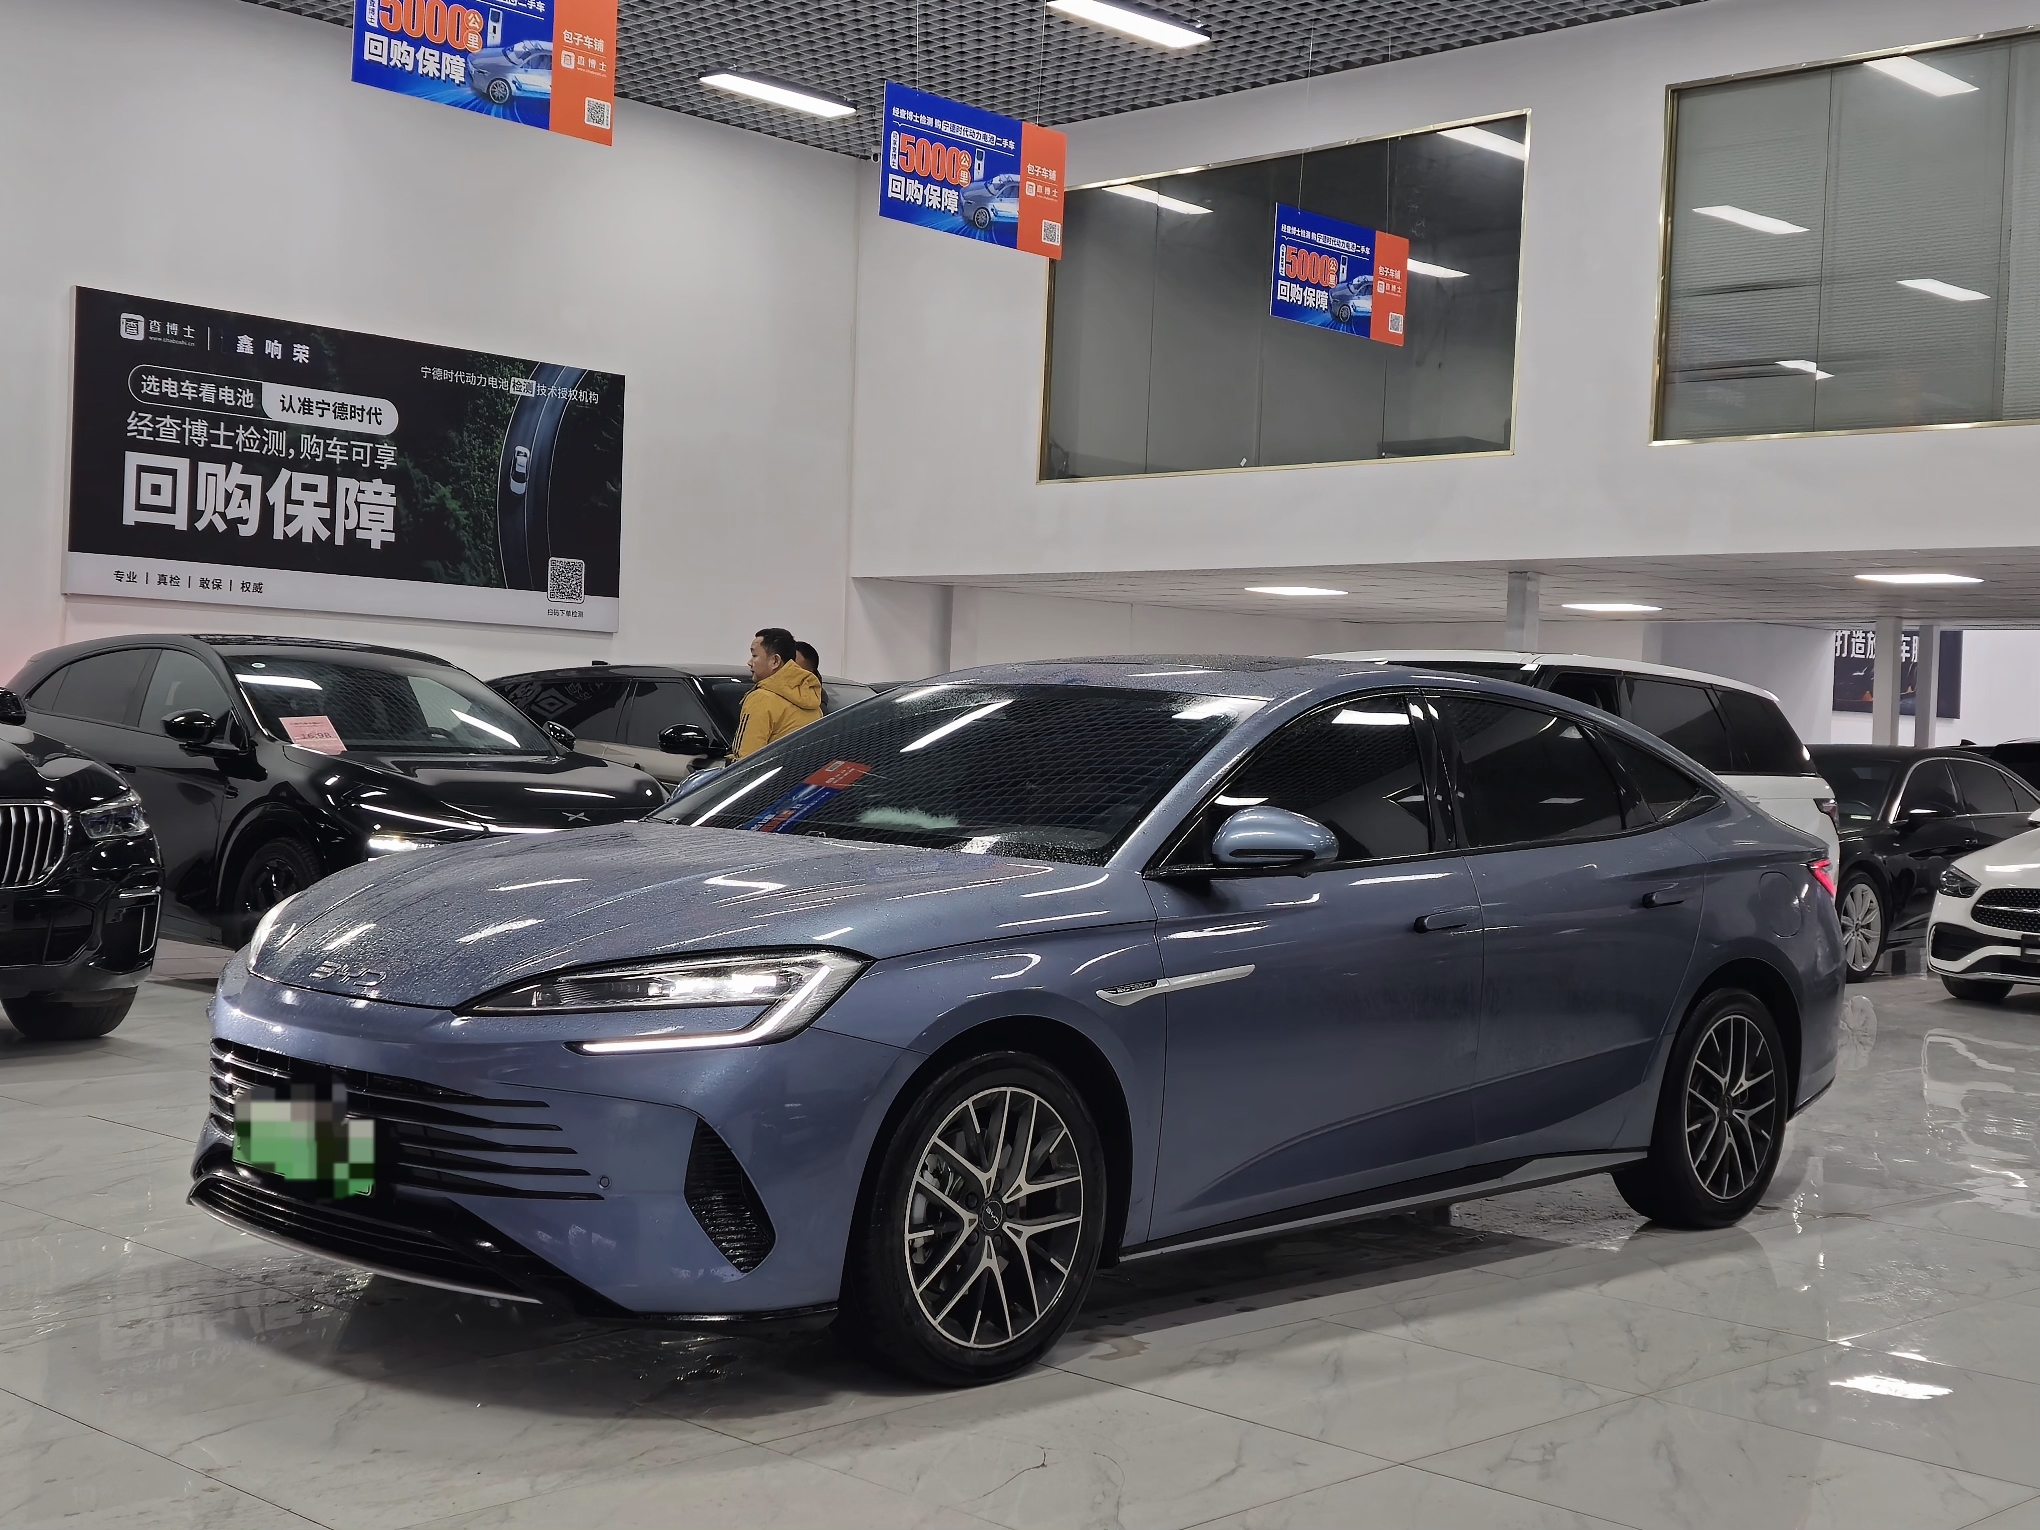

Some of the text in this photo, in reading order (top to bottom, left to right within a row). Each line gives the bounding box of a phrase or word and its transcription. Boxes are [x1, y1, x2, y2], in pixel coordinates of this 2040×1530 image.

[467, 11, 481, 50] 公里
[563, 30, 605, 53] 包子车铺
[364, 31, 466, 84] 回购保障
[899, 132, 961, 185] 5000
[959, 152, 971, 184] 公里
[1027, 163, 1057, 181] 包子车铺
[887, 173, 959, 213] 回购保障
[1285, 245, 1330, 286] 5000
[1277, 280, 1329, 310] 回购保障
[149, 319, 196, 339] 查博士
[236, 334, 311, 364] 鑫响荣
[141, 374, 383, 426] 选电车看电池 认准宁德时代
[420, 366, 599, 405] 宁德时代动力电池检测技术授权机构
[122, 450, 397, 550] 回购保障
[113, 570, 264, 594] 专业 真检 敢保 权威
[547, 608, 584, 618] 扫码下单检测
[308, 960, 387, 988] BYD
